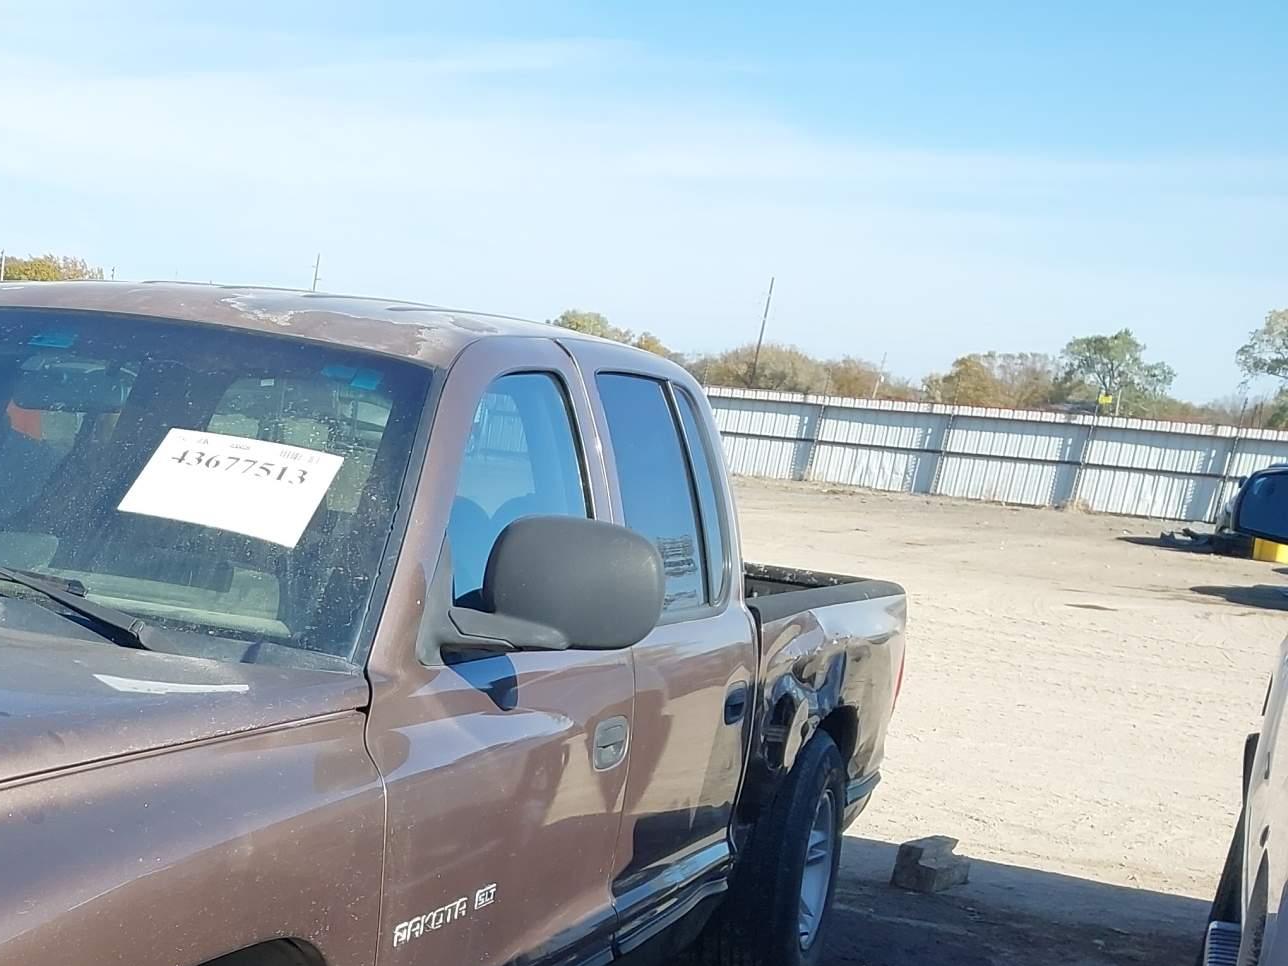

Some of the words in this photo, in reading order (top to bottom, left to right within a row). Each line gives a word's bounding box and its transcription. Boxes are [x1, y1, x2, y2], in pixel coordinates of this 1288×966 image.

[171, 450, 308, 485] 43677513
[393, 897, 468, 947] DAKOTA
[476, 886, 496, 908] SLT
